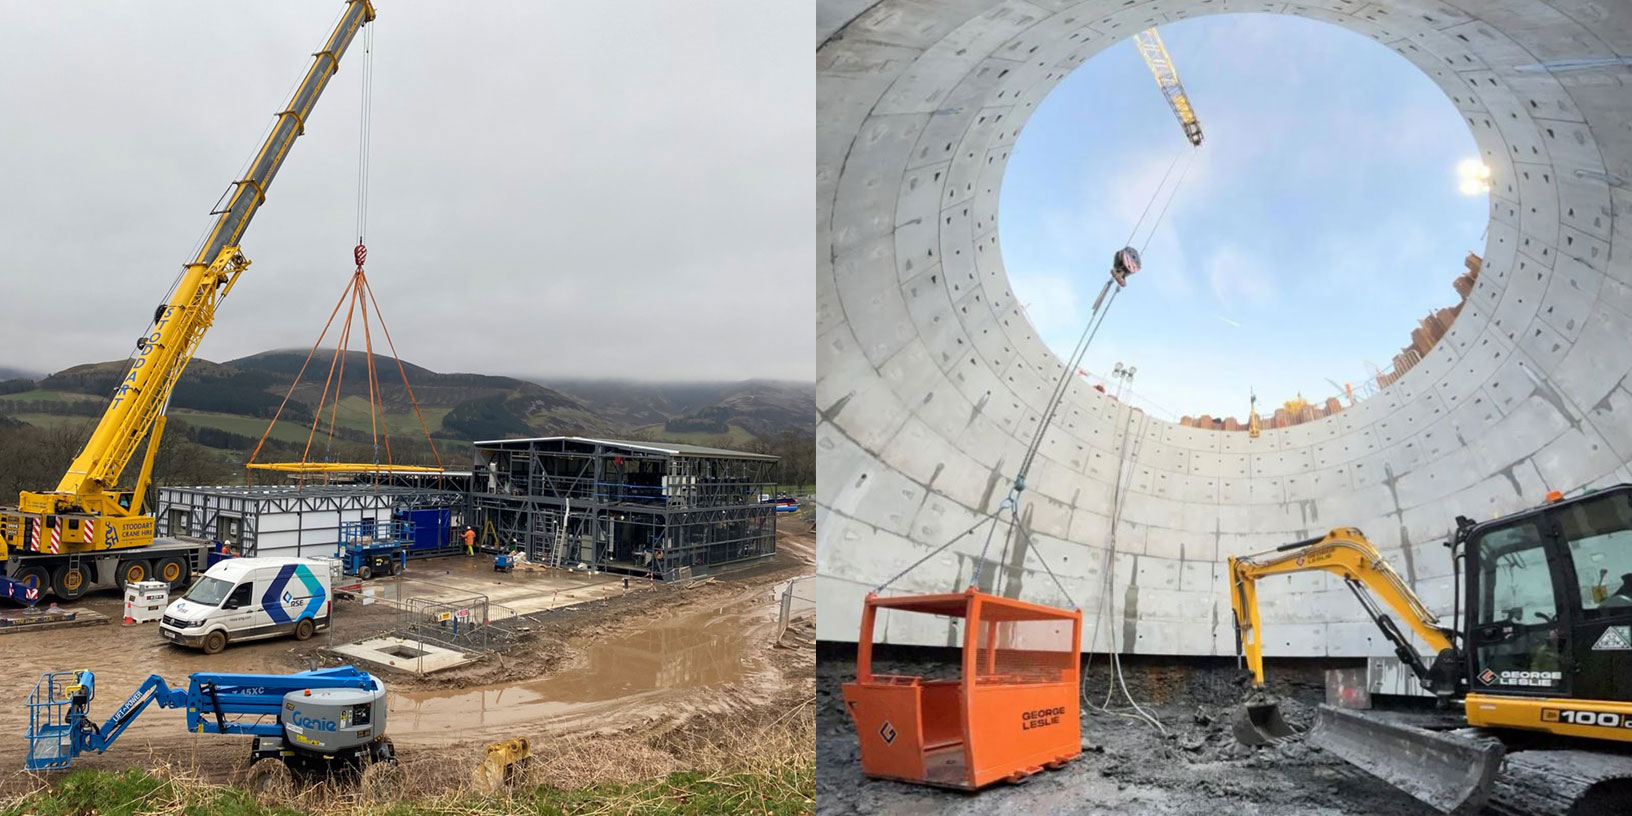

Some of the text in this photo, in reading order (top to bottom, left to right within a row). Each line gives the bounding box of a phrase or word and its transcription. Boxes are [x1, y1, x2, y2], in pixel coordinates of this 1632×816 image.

[112, 306, 175, 410] STODDART
[122, 521, 153, 531] STODDART
[122, 530, 140, 538] CRANE
[291, 600, 304, 608] RSE
[1500, 671, 1562, 679] GEORGE
[1500, 678, 1552, 686] LESLIE
[1022, 706, 1066, 721] GEORGE
[292, 711, 337, 733] Genie
[1022, 716, 1060, 730] LESLIE
